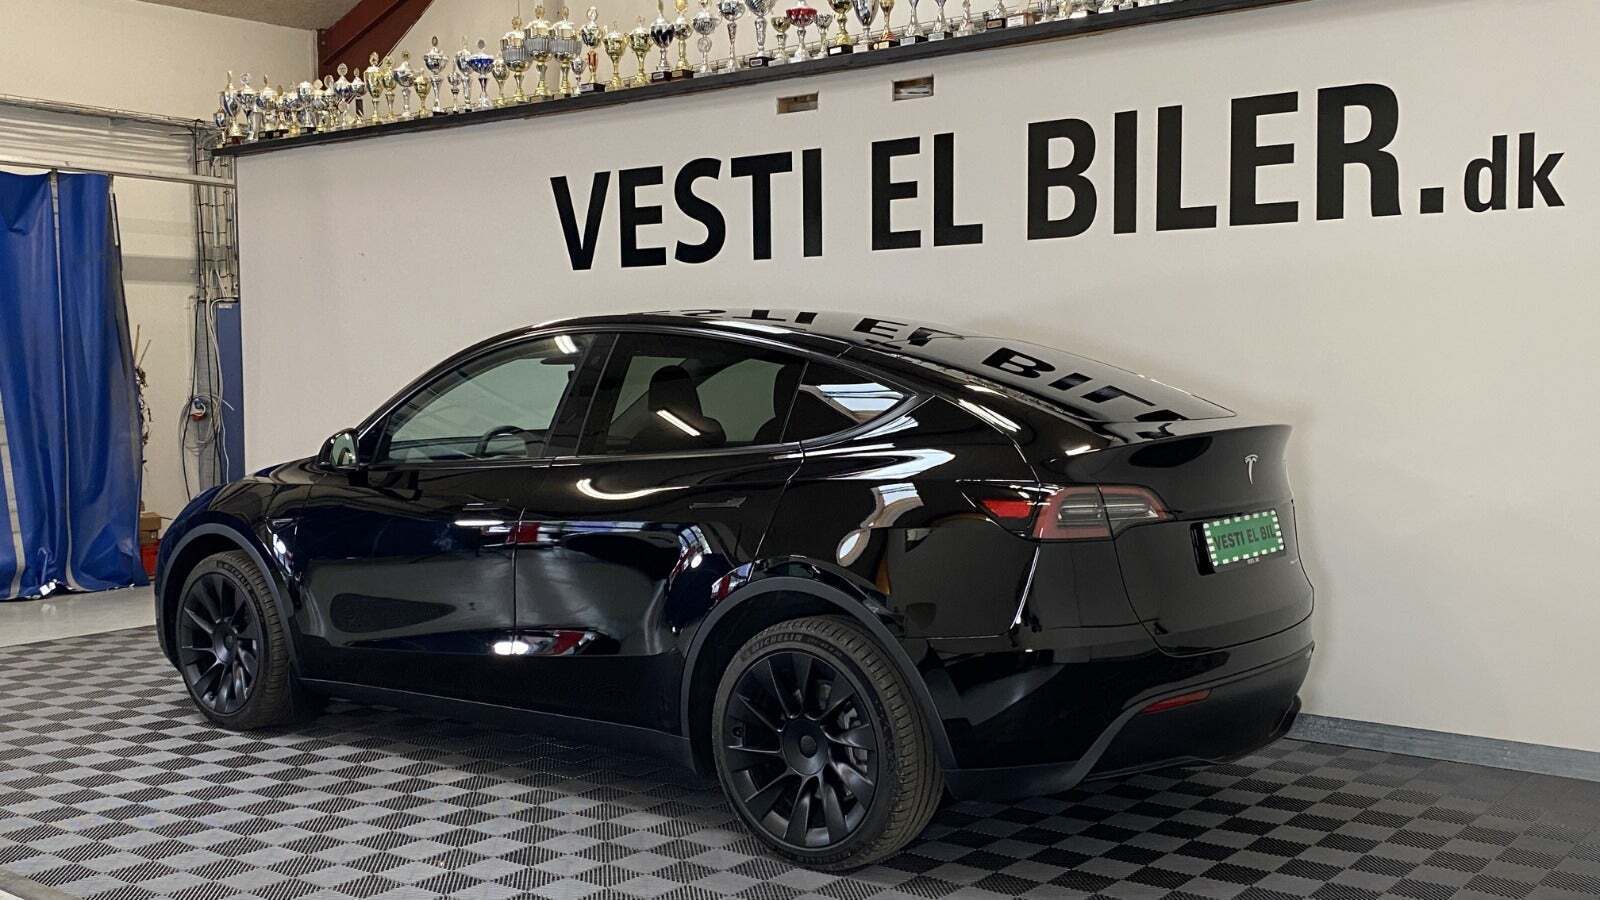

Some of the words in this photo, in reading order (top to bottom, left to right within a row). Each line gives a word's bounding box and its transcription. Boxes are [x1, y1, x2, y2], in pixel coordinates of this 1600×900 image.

[550, 147, 823, 271] VESTI
[871, 132, 983, 250] EL
[1213, 531, 1245, 550] VESTI
[1246, 528, 1260, 544] EL
